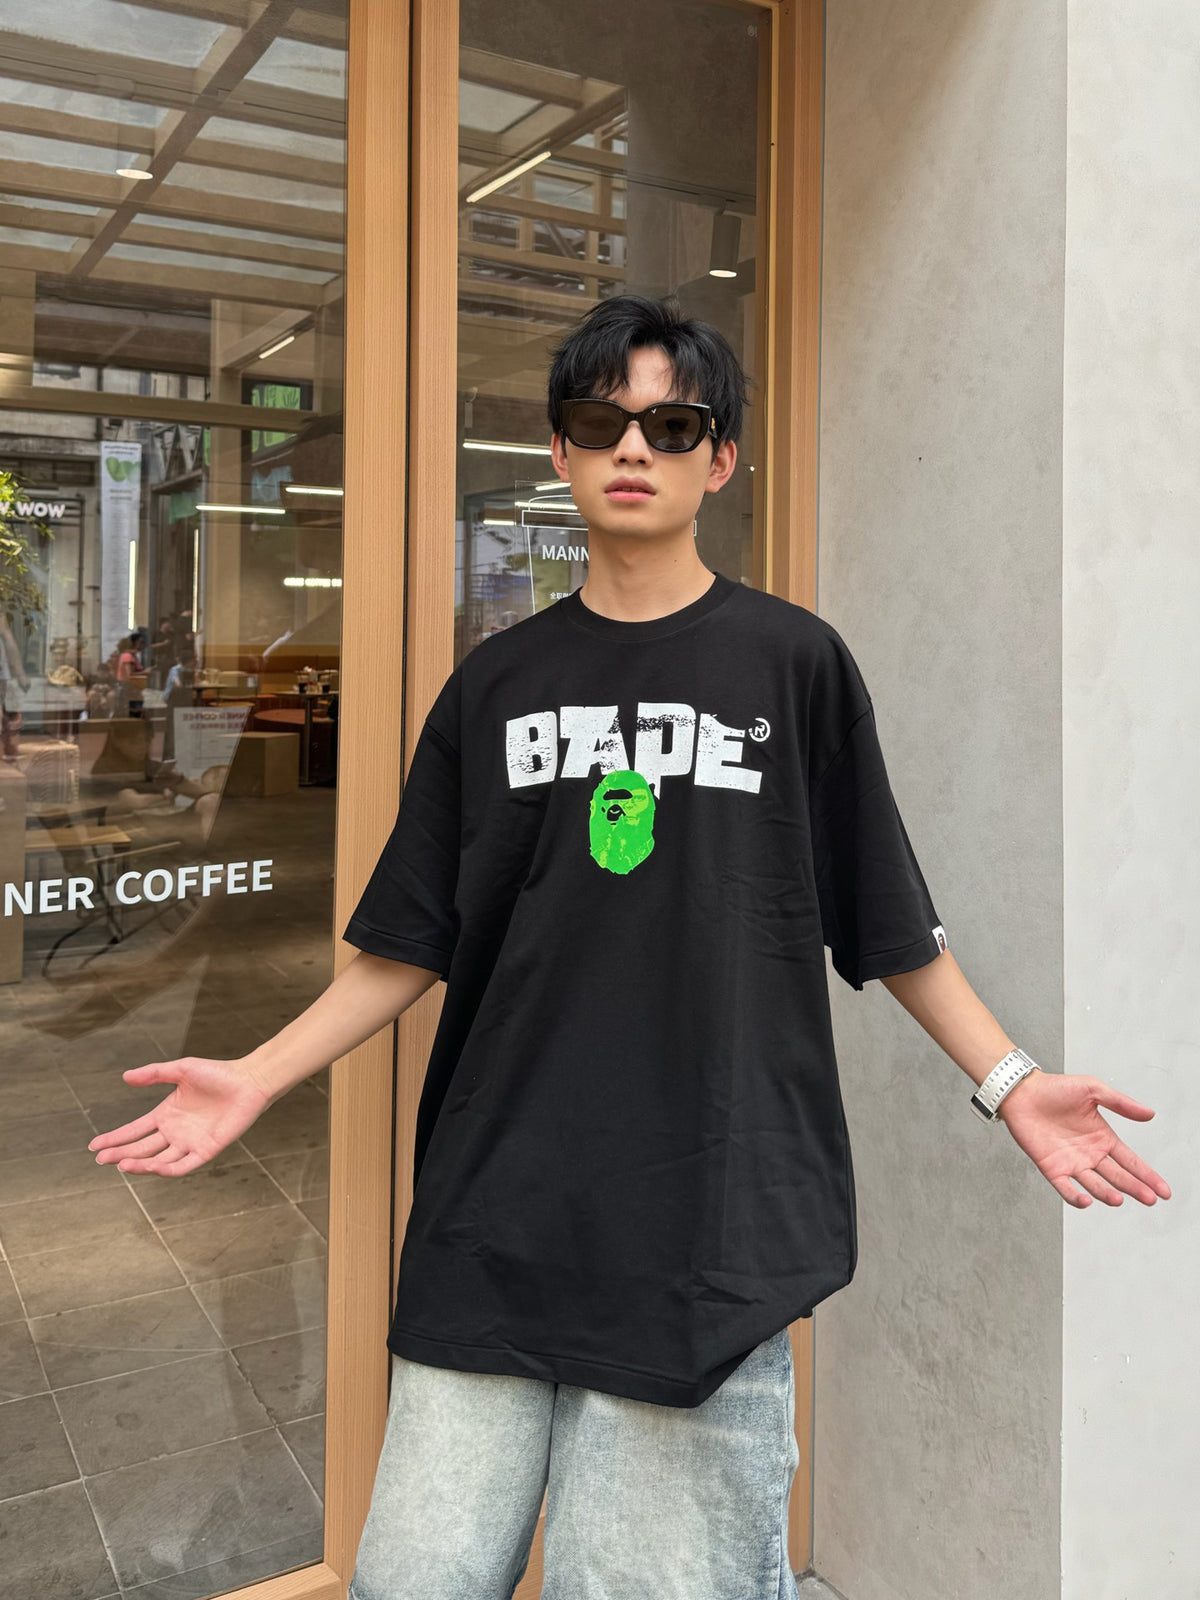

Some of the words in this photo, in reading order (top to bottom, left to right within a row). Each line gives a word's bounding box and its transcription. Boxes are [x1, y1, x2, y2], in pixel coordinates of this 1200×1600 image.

[16, 500, 66, 518] WOW
[542, 544, 590, 561] MANN
[4, 876, 95, 917] NER
[115, 859, 273, 905] COFFEE
